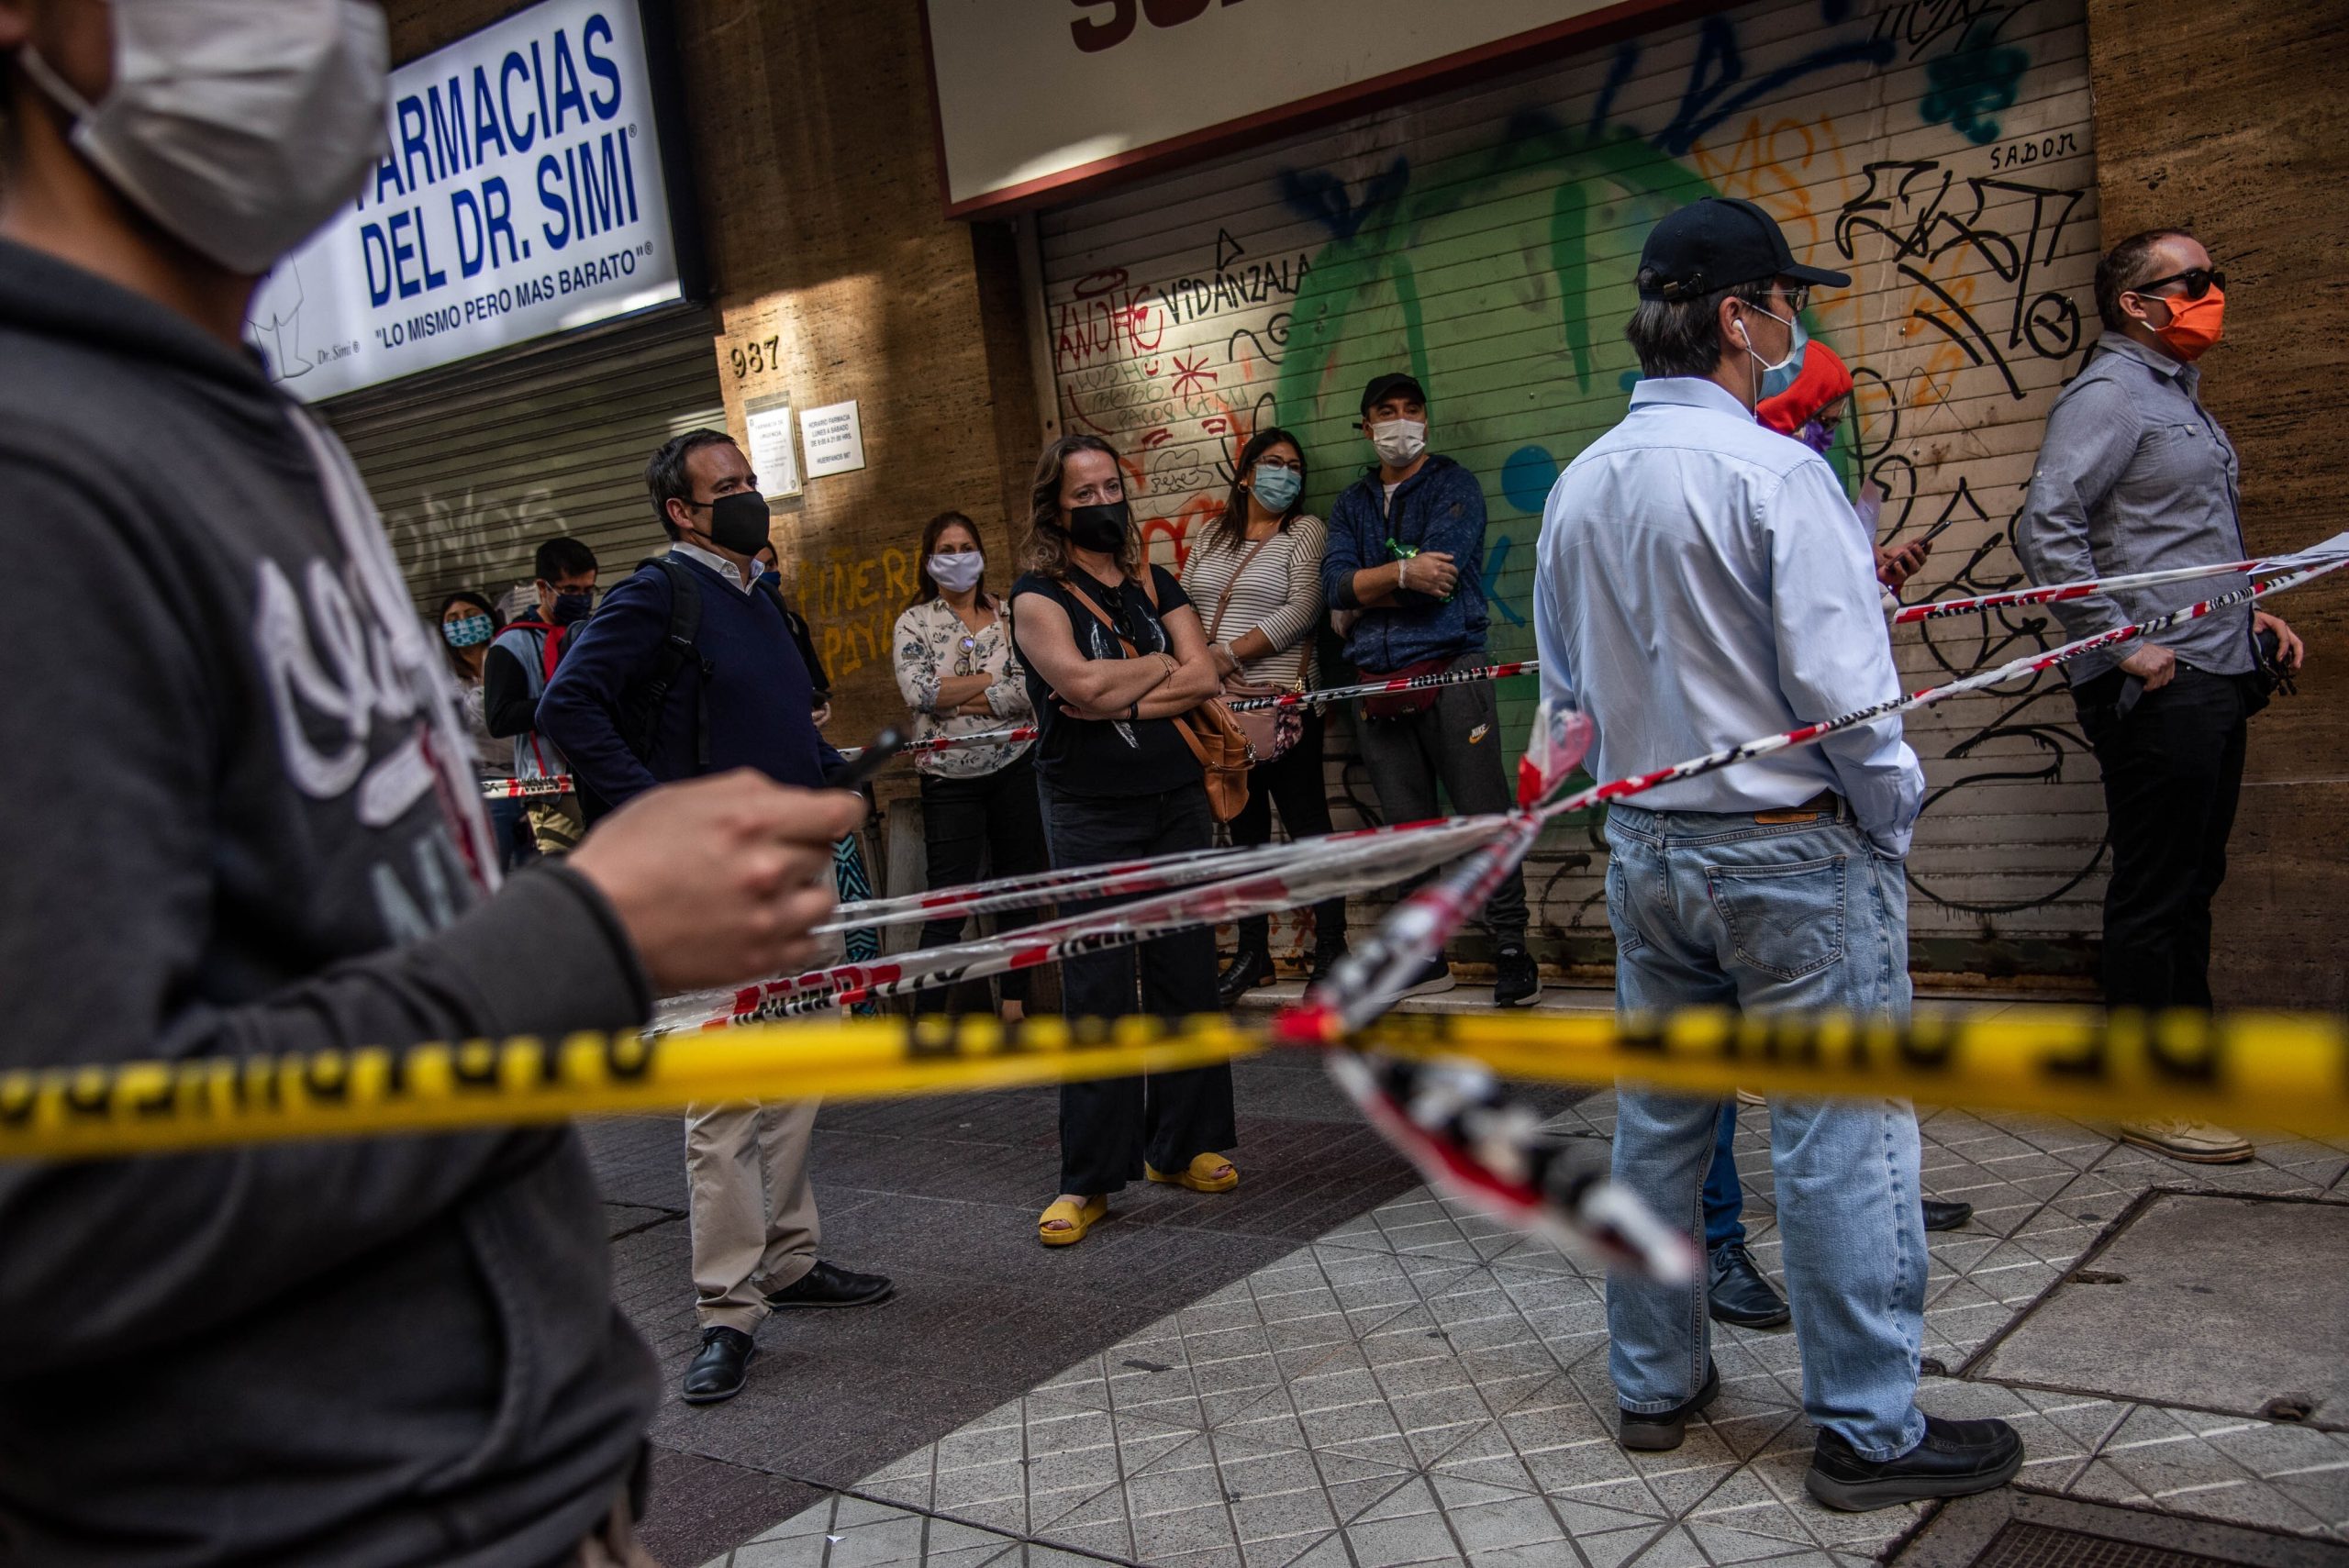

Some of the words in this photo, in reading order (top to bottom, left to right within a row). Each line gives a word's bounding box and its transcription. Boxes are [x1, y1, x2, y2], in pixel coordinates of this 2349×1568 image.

[357, 14, 622, 212] ARMACIAS
[361, 206, 447, 309] DEL
[451, 176, 531, 278] DR.
[407, 306, 461, 341] MISMO
[464, 288, 511, 324] PERO
[516, 275, 554, 308] MAS
[829, 414, 851, 423] FARMACIA
